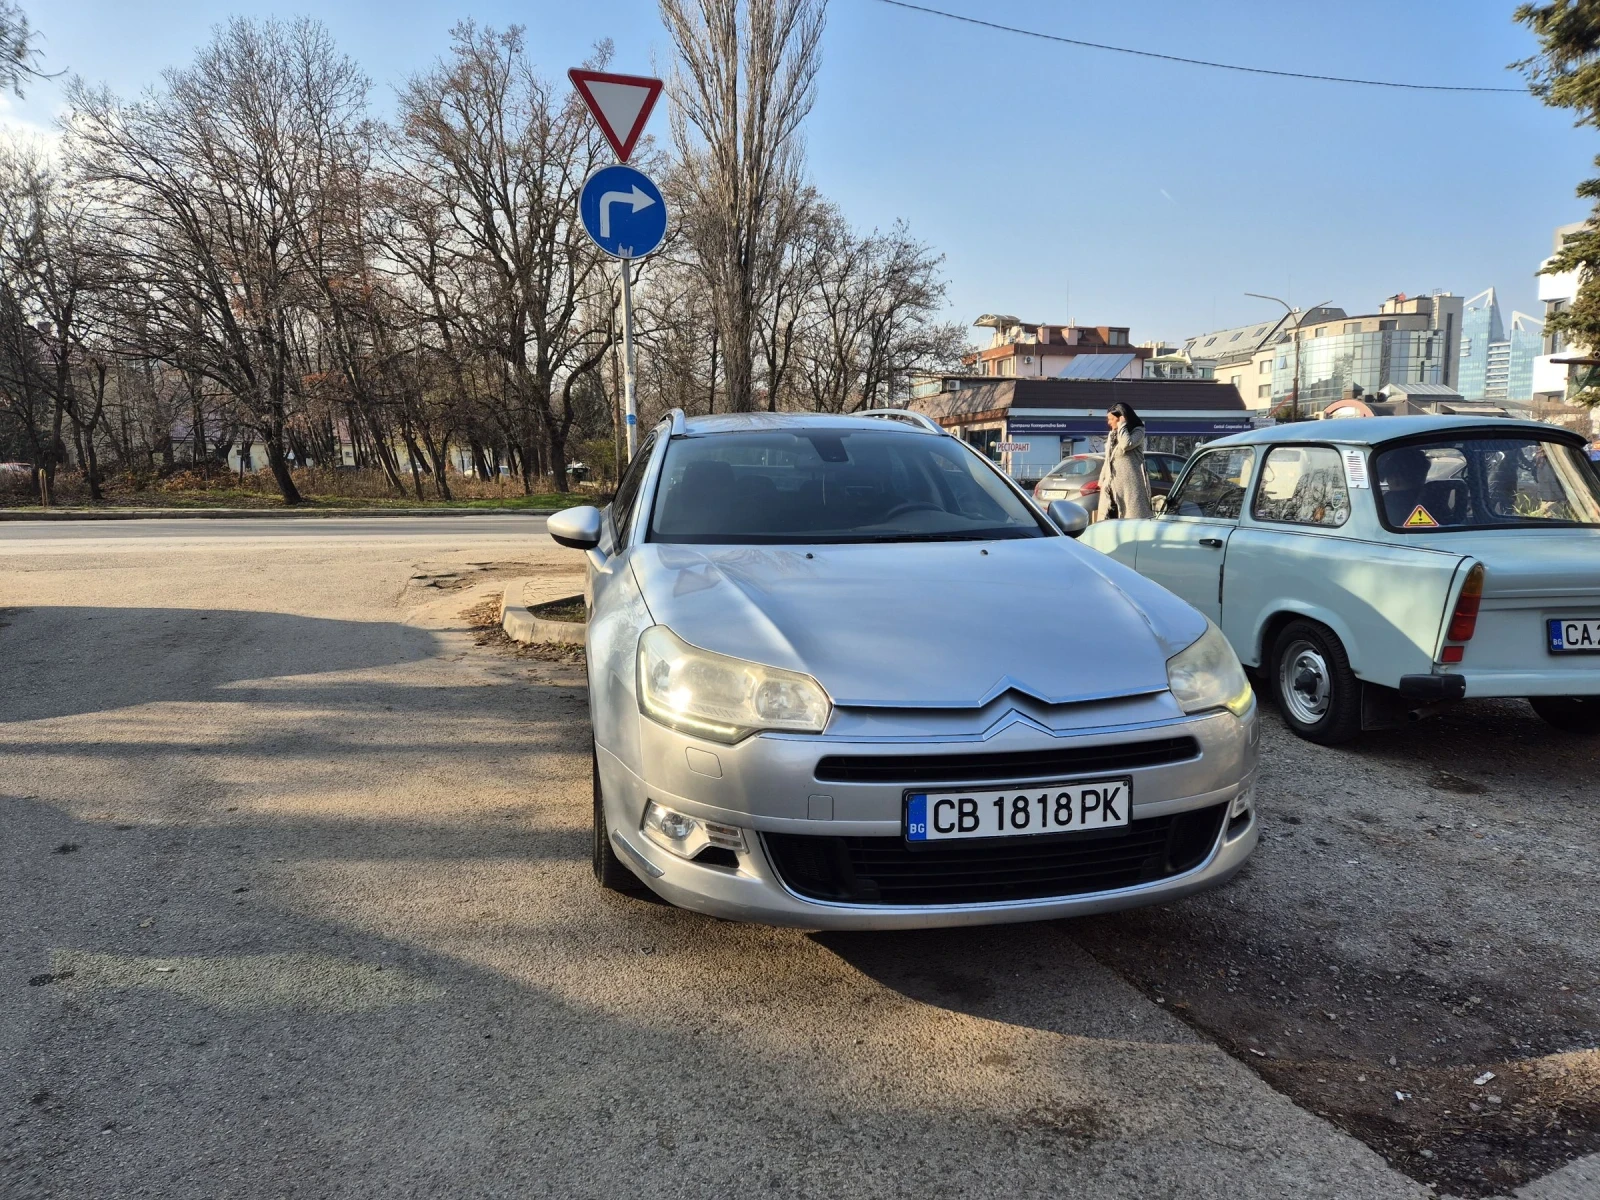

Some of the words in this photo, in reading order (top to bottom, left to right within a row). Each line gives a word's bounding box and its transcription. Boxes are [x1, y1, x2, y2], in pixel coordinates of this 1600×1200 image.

[997, 443, 1029, 452] РЕСТОРАНТ
[1552, 638, 1563, 646] BG
[993, 791, 1073, 831] 1818
[909, 823, 925, 834] BG
